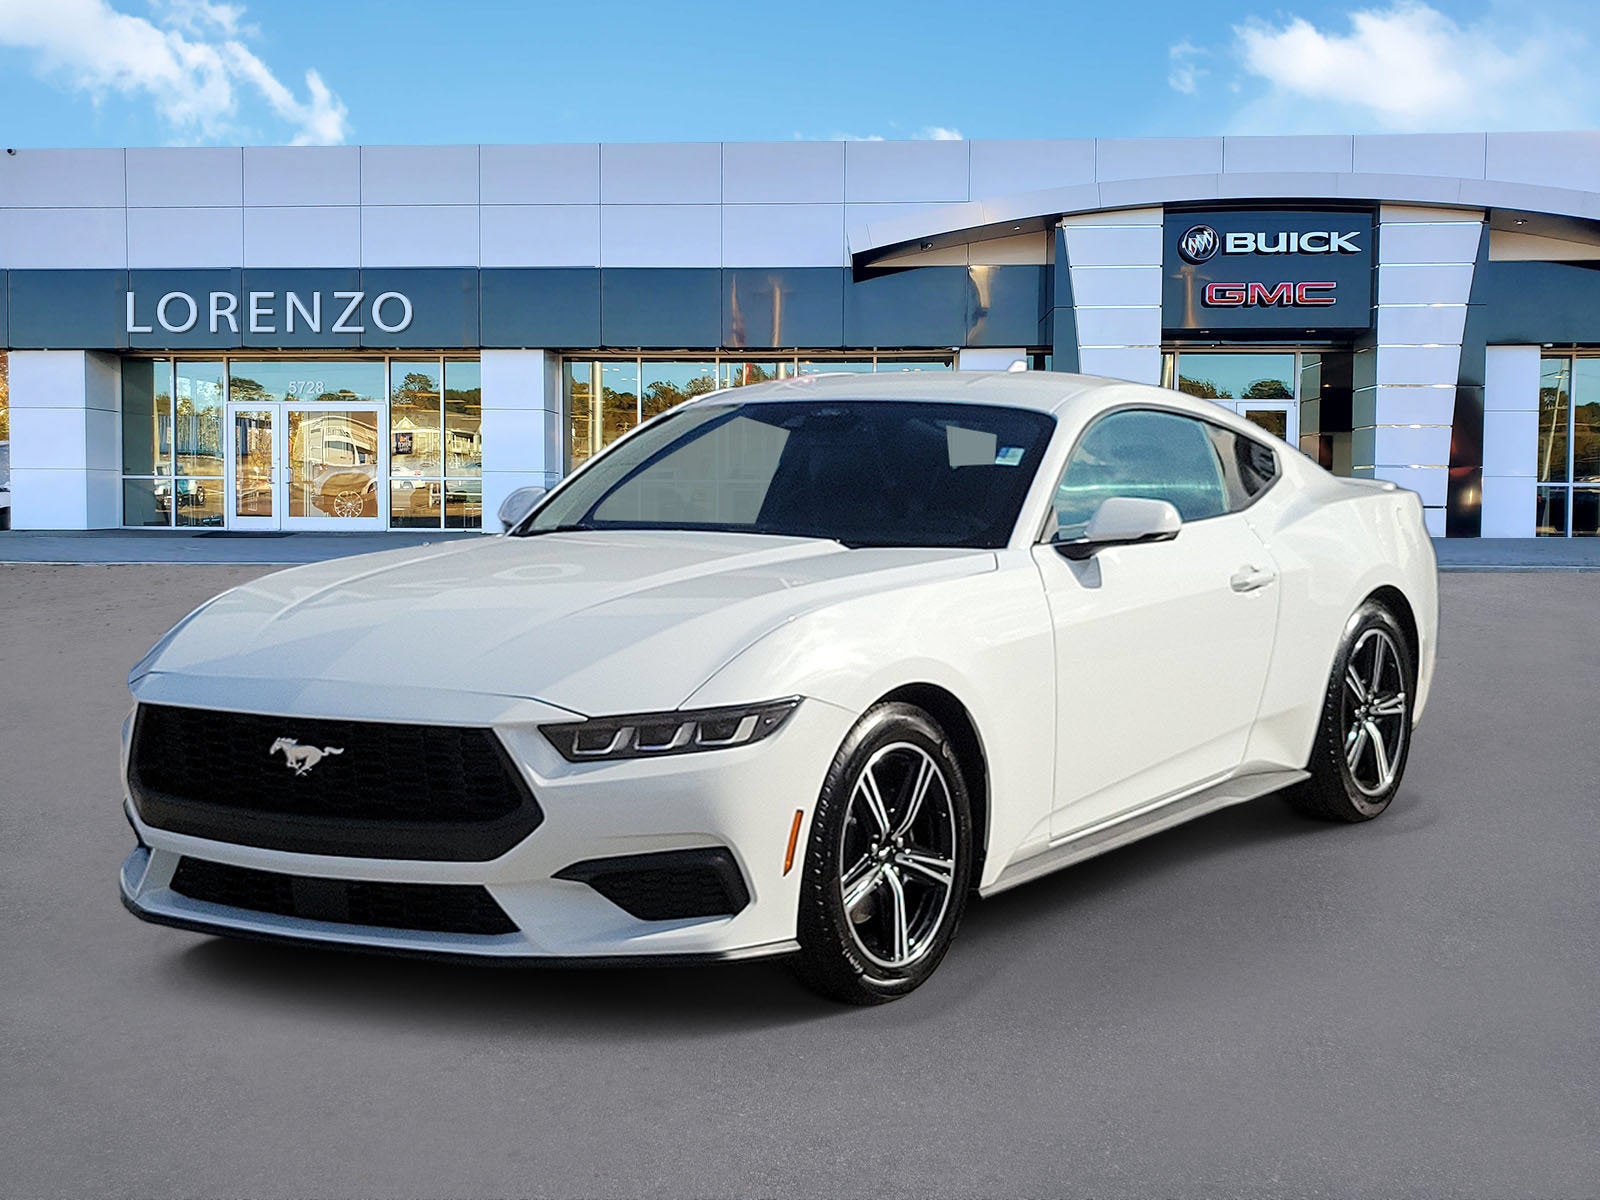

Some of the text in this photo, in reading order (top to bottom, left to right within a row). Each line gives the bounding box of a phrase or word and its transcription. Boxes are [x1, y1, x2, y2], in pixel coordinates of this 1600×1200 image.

[1225, 231, 1362, 253] BUICK
[1205, 281, 1337, 306] GMC
[126, 291, 413, 333] LORENZO
[288, 381, 324, 394] 5728
